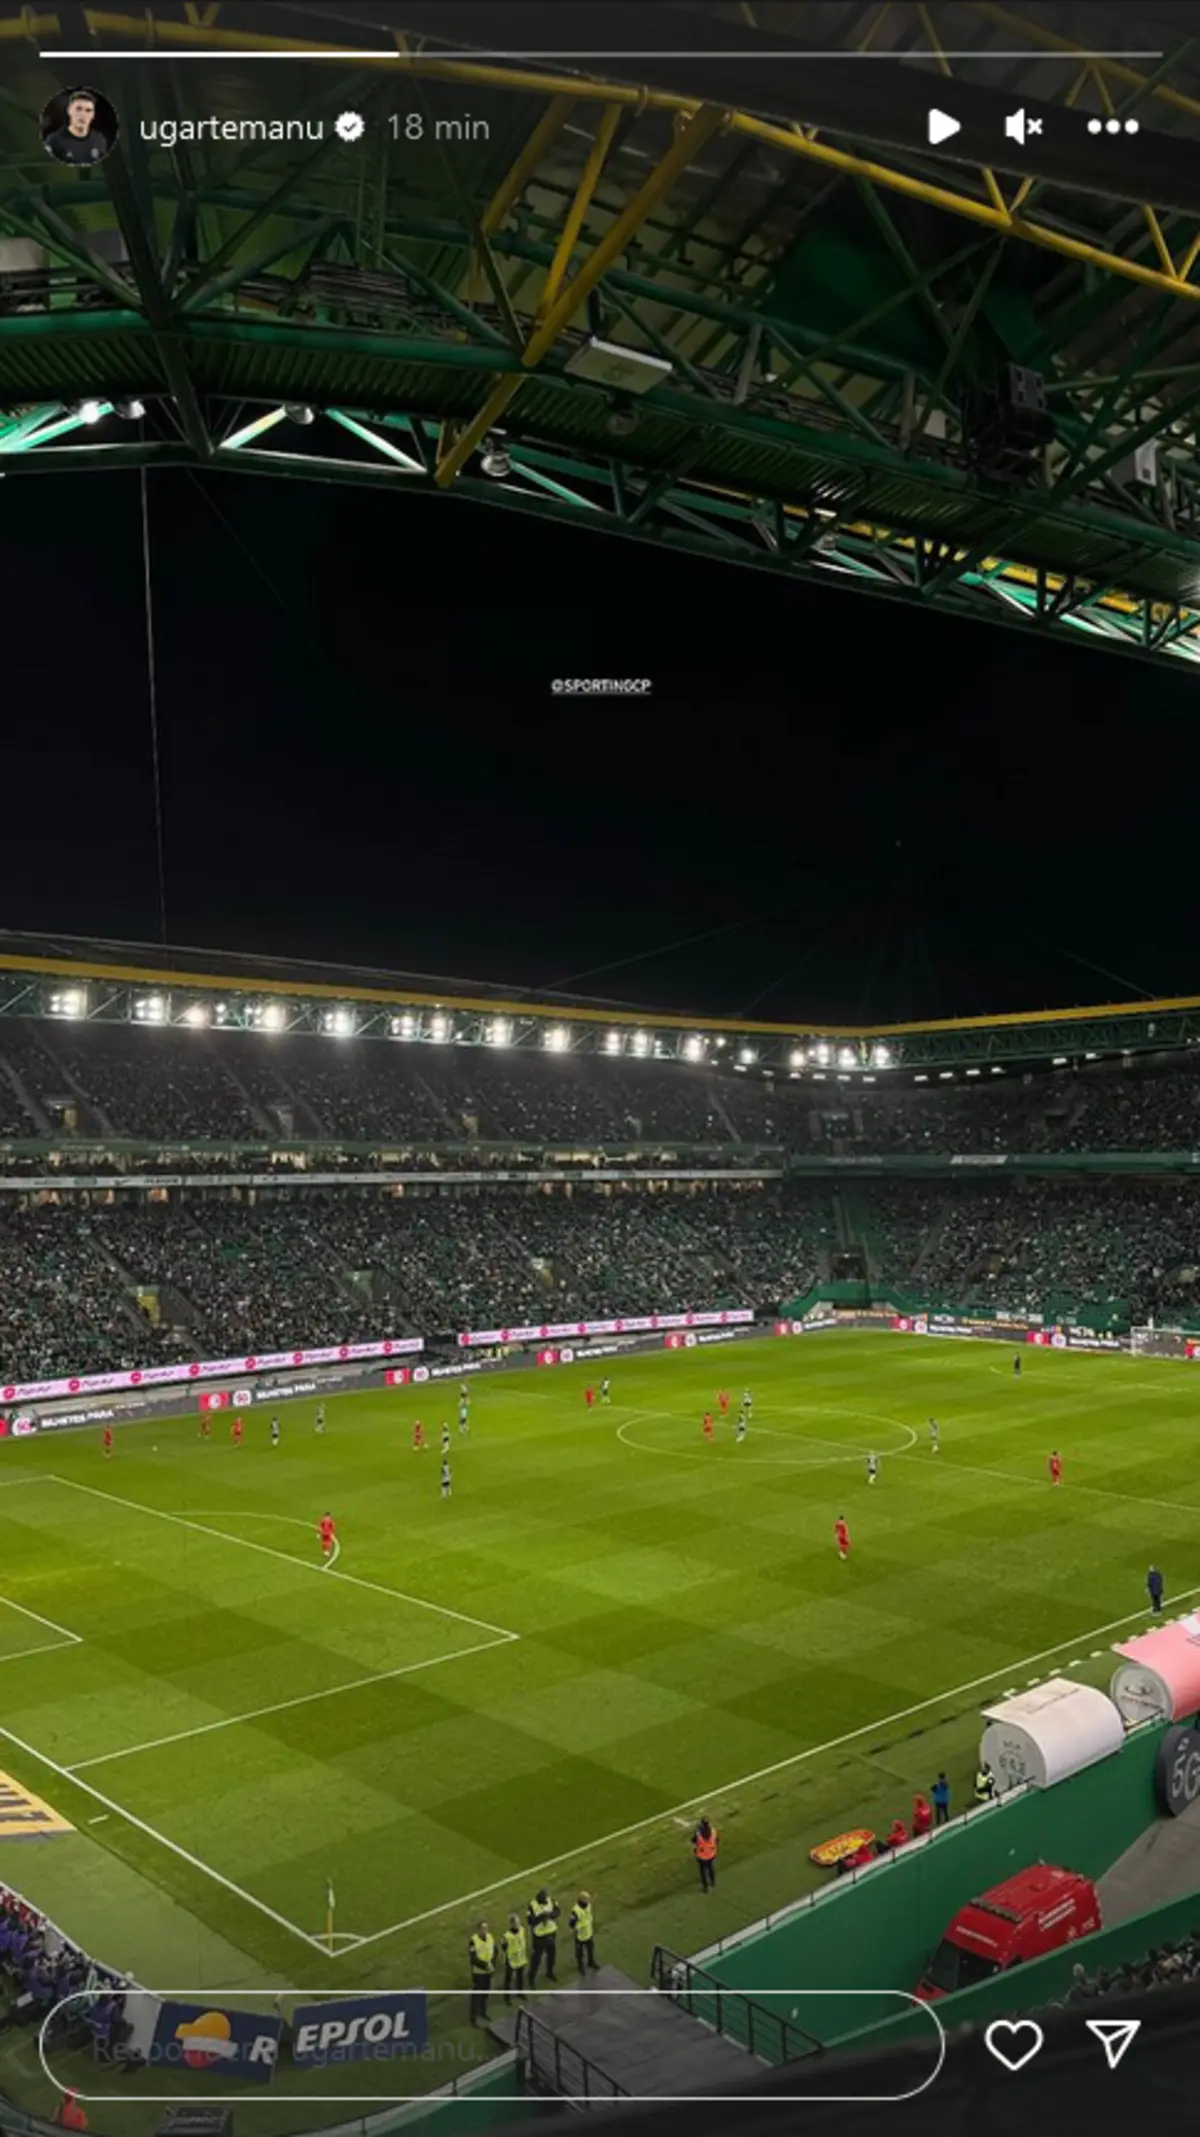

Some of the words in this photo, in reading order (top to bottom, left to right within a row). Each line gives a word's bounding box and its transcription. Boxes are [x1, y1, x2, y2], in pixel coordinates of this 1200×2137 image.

[1171, 1751, 1200, 1802] 5G
[249, 2034, 278, 2065] R
[296, 2010, 410, 2053] EPSOL
